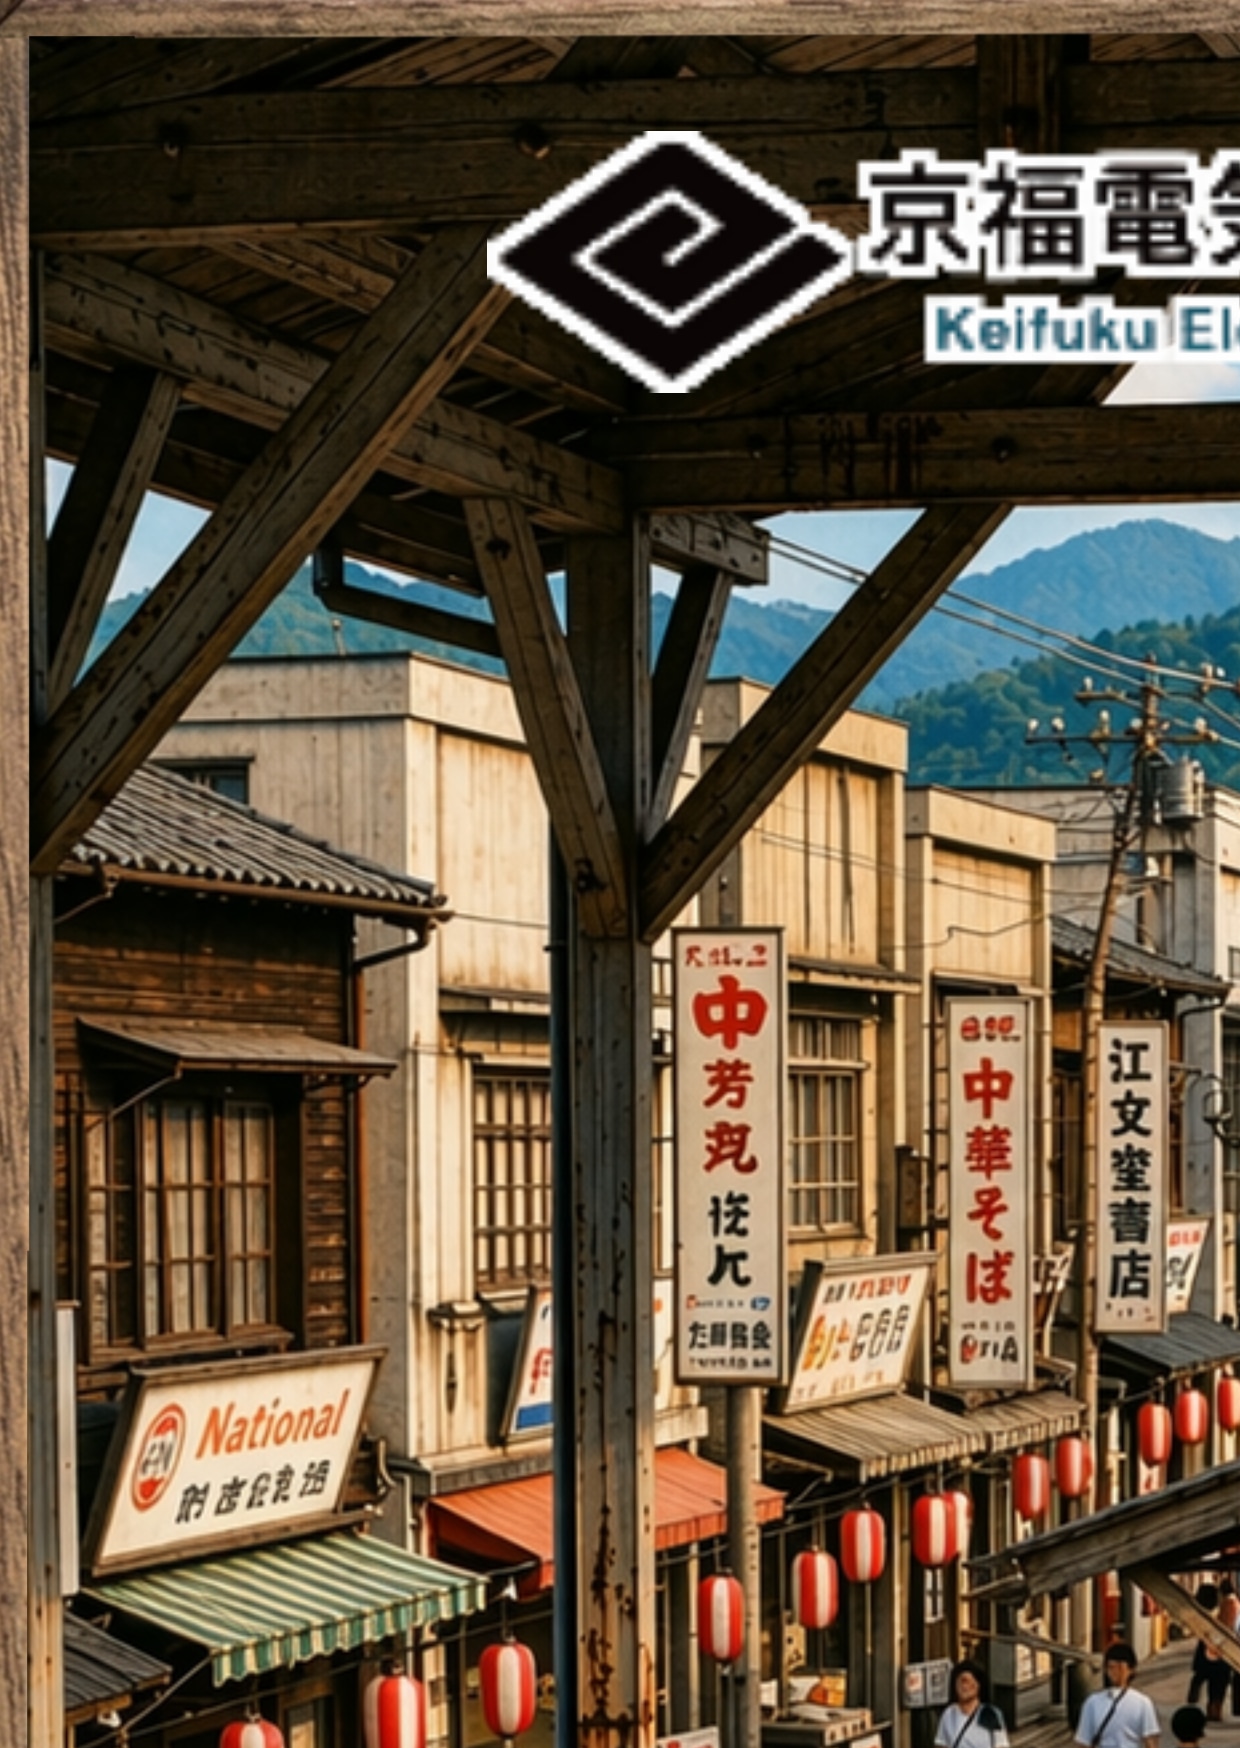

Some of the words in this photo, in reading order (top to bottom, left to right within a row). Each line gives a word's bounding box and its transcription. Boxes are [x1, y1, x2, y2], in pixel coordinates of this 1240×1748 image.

[962, 1056, 1016, 1305] 中華そば
[195, 1386, 352, 1460] National
